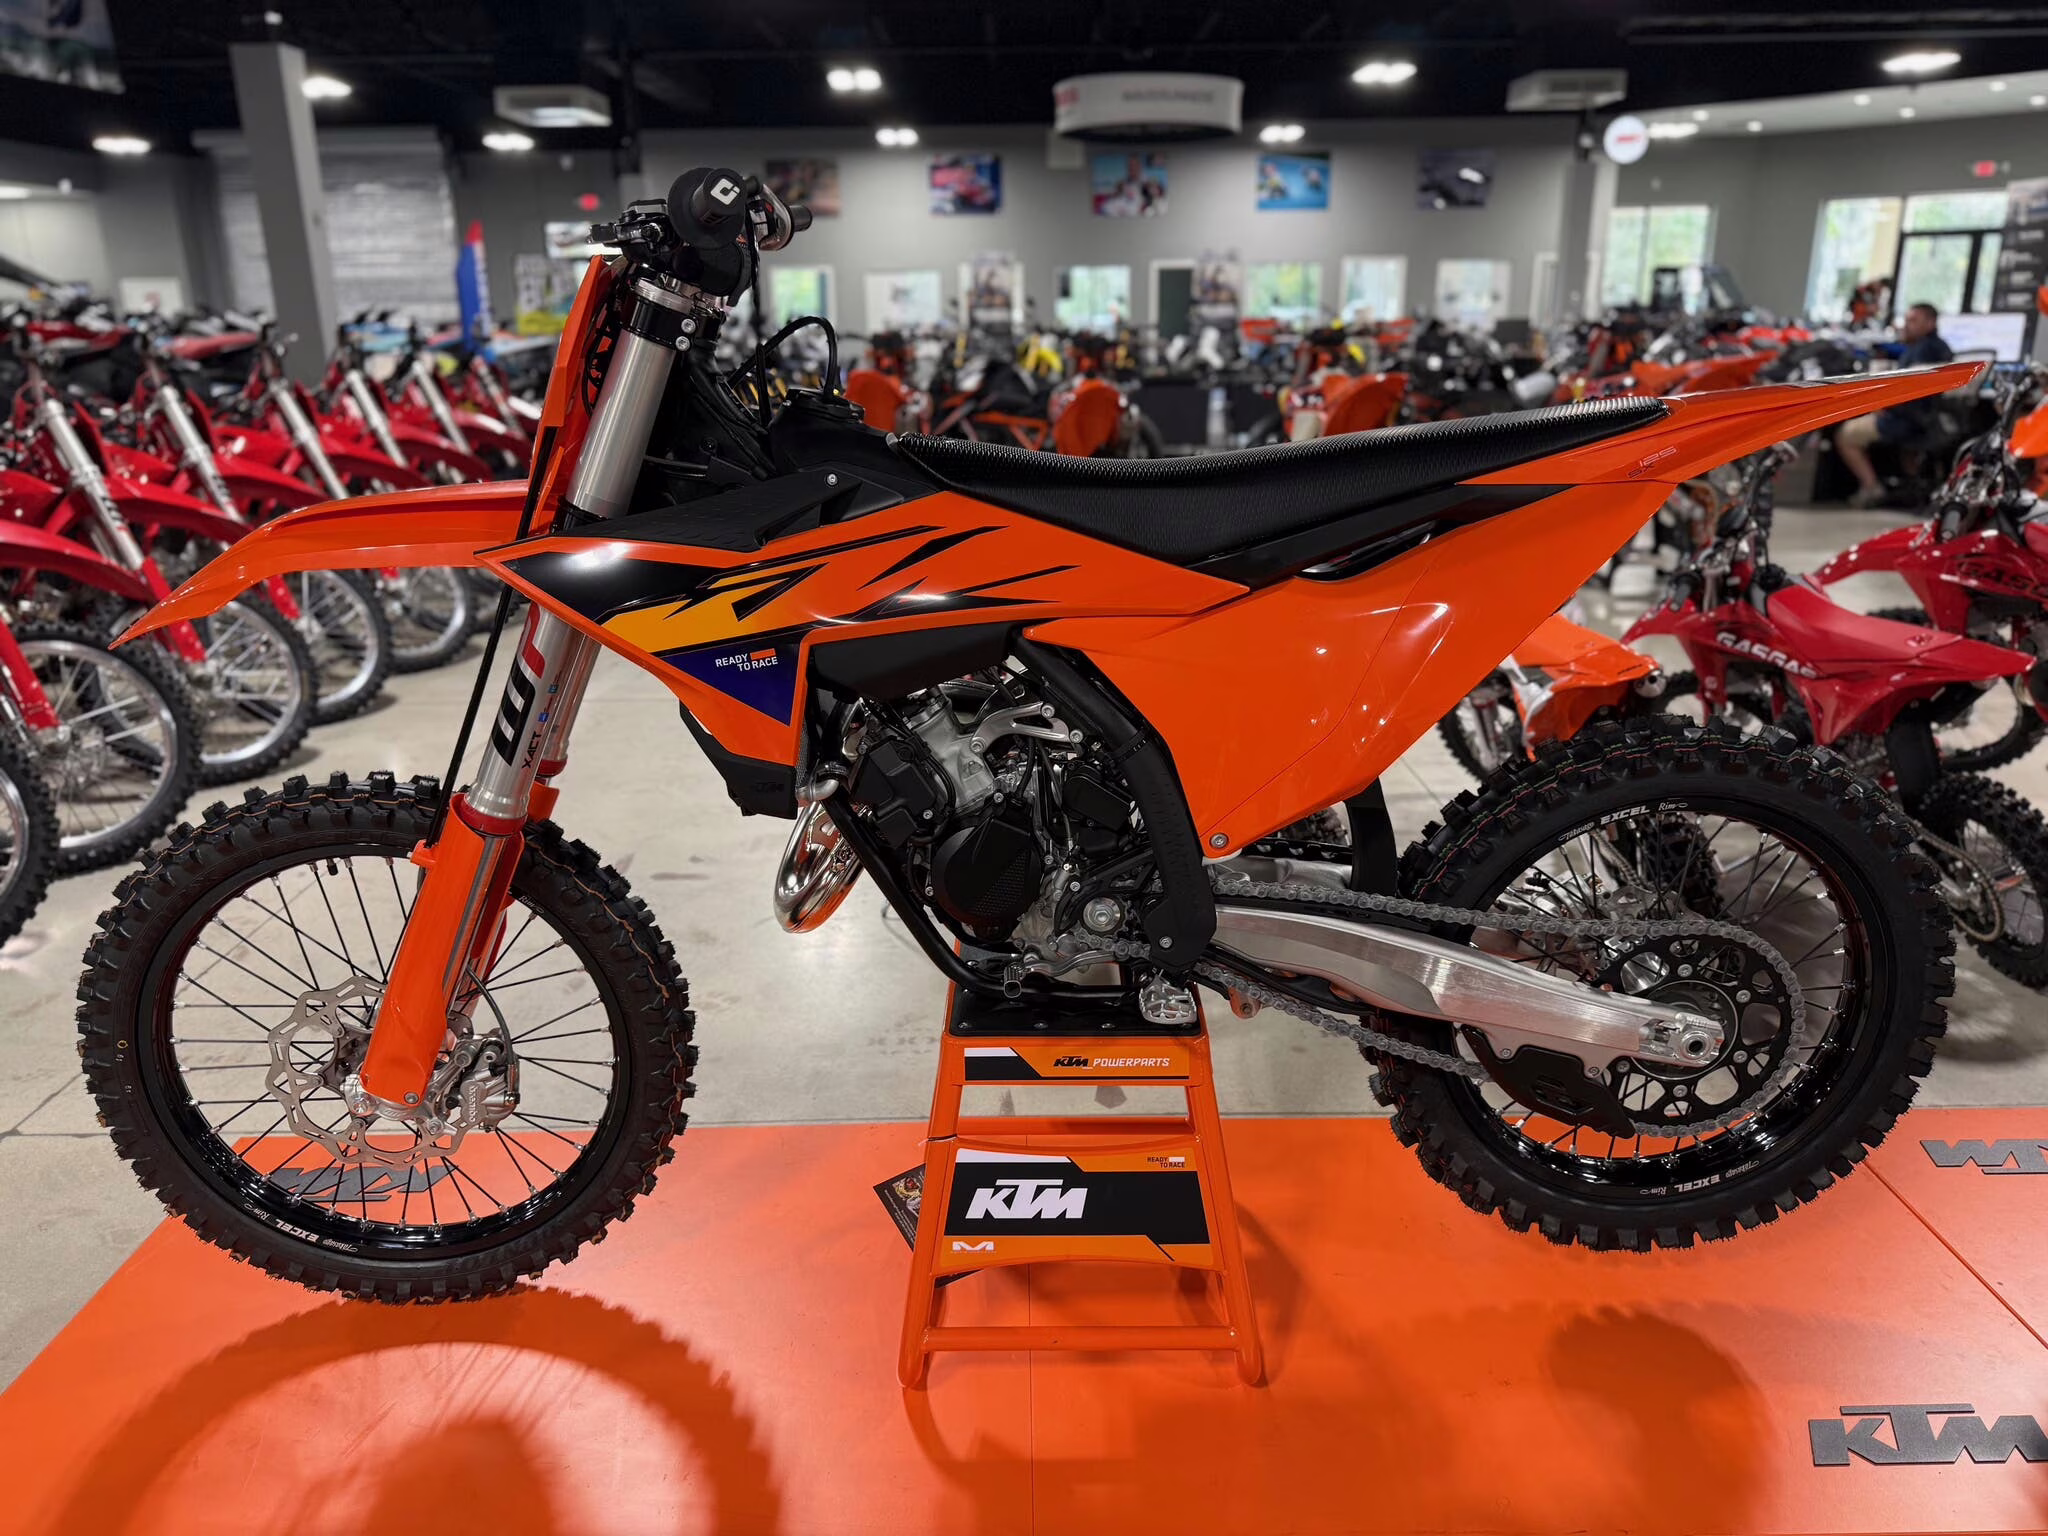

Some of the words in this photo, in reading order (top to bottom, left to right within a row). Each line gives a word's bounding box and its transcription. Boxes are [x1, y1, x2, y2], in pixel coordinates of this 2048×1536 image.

[1640, 444, 1677, 467] 125
[1628, 462, 1655, 478] SX
[715, 653, 748, 667] READY
[737, 661, 751, 672] TO
[752, 656, 778, 669] RACE
[1716, 632, 1817, 679] GASGAS
[521, 731, 542, 769] XACT
[1600, 805, 1650, 825] EXCEL
[1658, 802, 1684, 811] Rim
[1054, 1055, 1089, 1067] KTM
[1093, 1057, 1170, 1067] POWERPARTS
[469, 1085, 478, 1122] brembo
[1920, 1139, 2048, 1174] TM
[1674, 1174, 1720, 1193] EXCEL
[965, 1179, 1088, 1219] KTM
[276, 1218, 319, 1243] EXCEL
[1808, 1403, 2048, 1467] KTM
